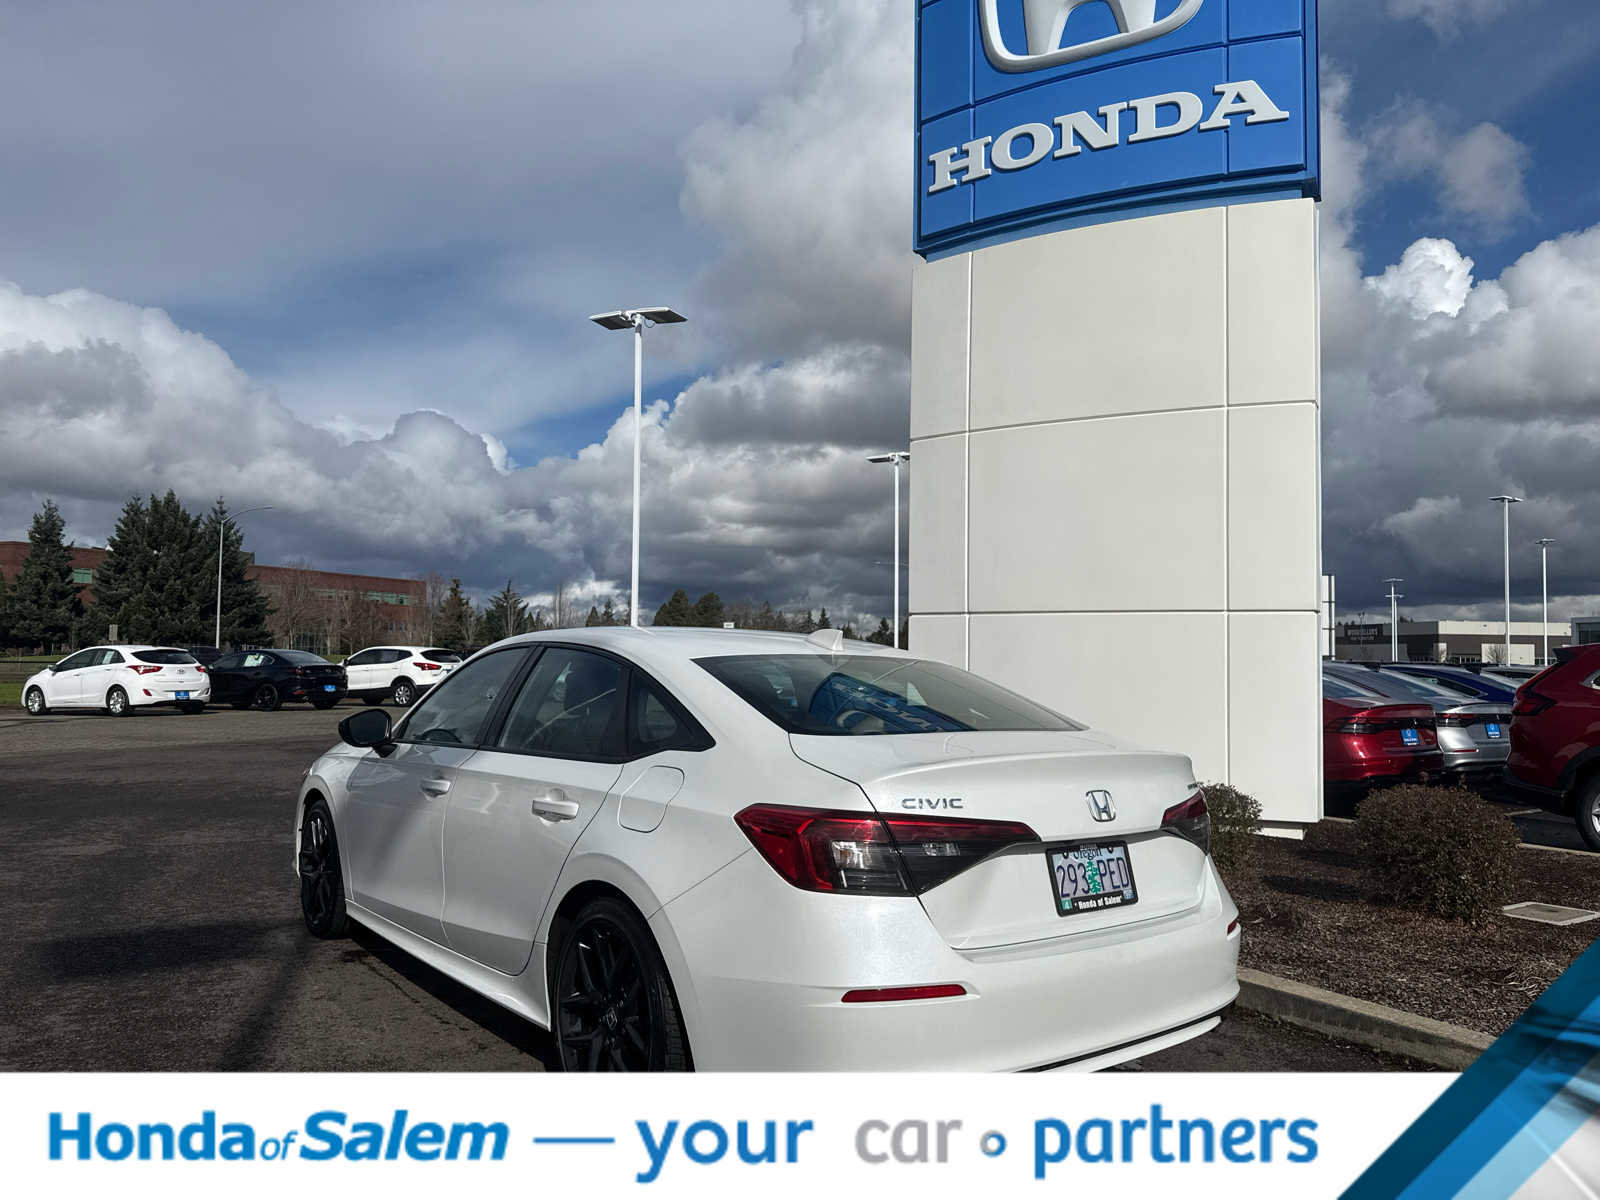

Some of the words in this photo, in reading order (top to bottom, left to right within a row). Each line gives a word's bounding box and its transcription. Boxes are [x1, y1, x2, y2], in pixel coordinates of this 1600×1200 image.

[928, 80, 1289, 192] HONDA
[901, 798, 963, 809] CIVIC
[1056, 862, 1091, 897] 293
[1096, 857, 1129, 891] PED
[1078, 899, 1097, 910] Honda
[1104, 895, 1122, 906] Salem
